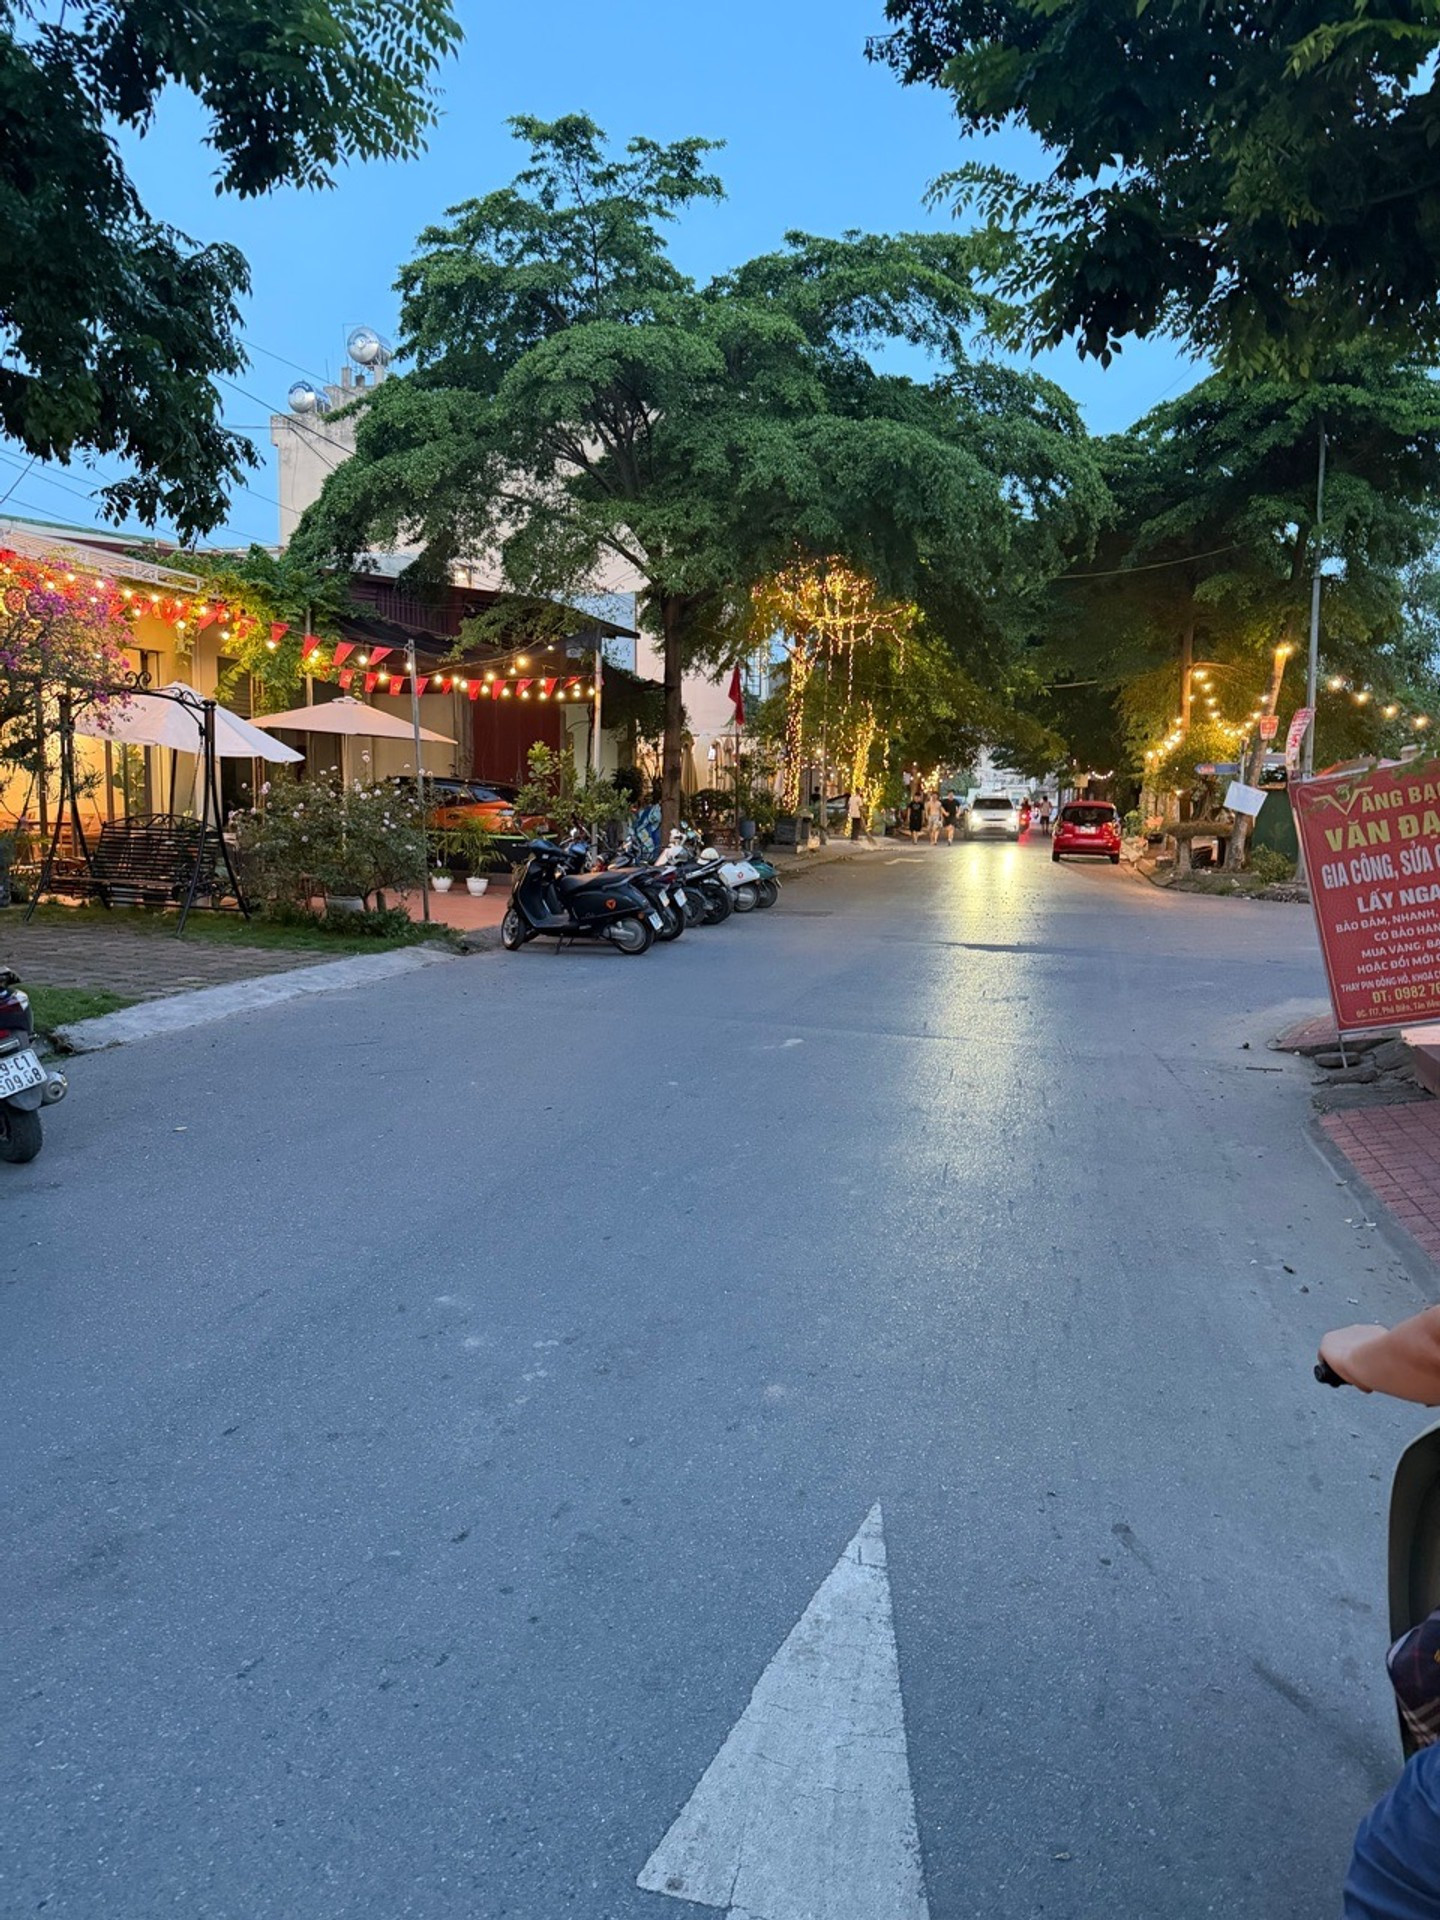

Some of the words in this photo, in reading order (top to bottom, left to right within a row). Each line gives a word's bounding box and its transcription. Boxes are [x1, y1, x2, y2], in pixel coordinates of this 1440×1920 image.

[1324, 819, 1391, 852] VĂN
[1321, 861, 1350, 890] GIA
[1350, 852, 1399, 885] CÔNG,
[1399, 841, 1434, 876] SỬA
[1356, 888, 1393, 913] LẤY
[1335, 919, 1359, 933] BẢO
[1373, 930, 1389, 942] CÓ
[1390, 925, 1414, 939] BẢO
[1357, 961, 1389, 974] HOẶC
[1411, 952, 1434, 966] MỚI
[1361, 946, 1387, 959] MUA
[1394, 983, 1426, 1001] 0982
[0, 1055, 31, 1077] 9-C1
